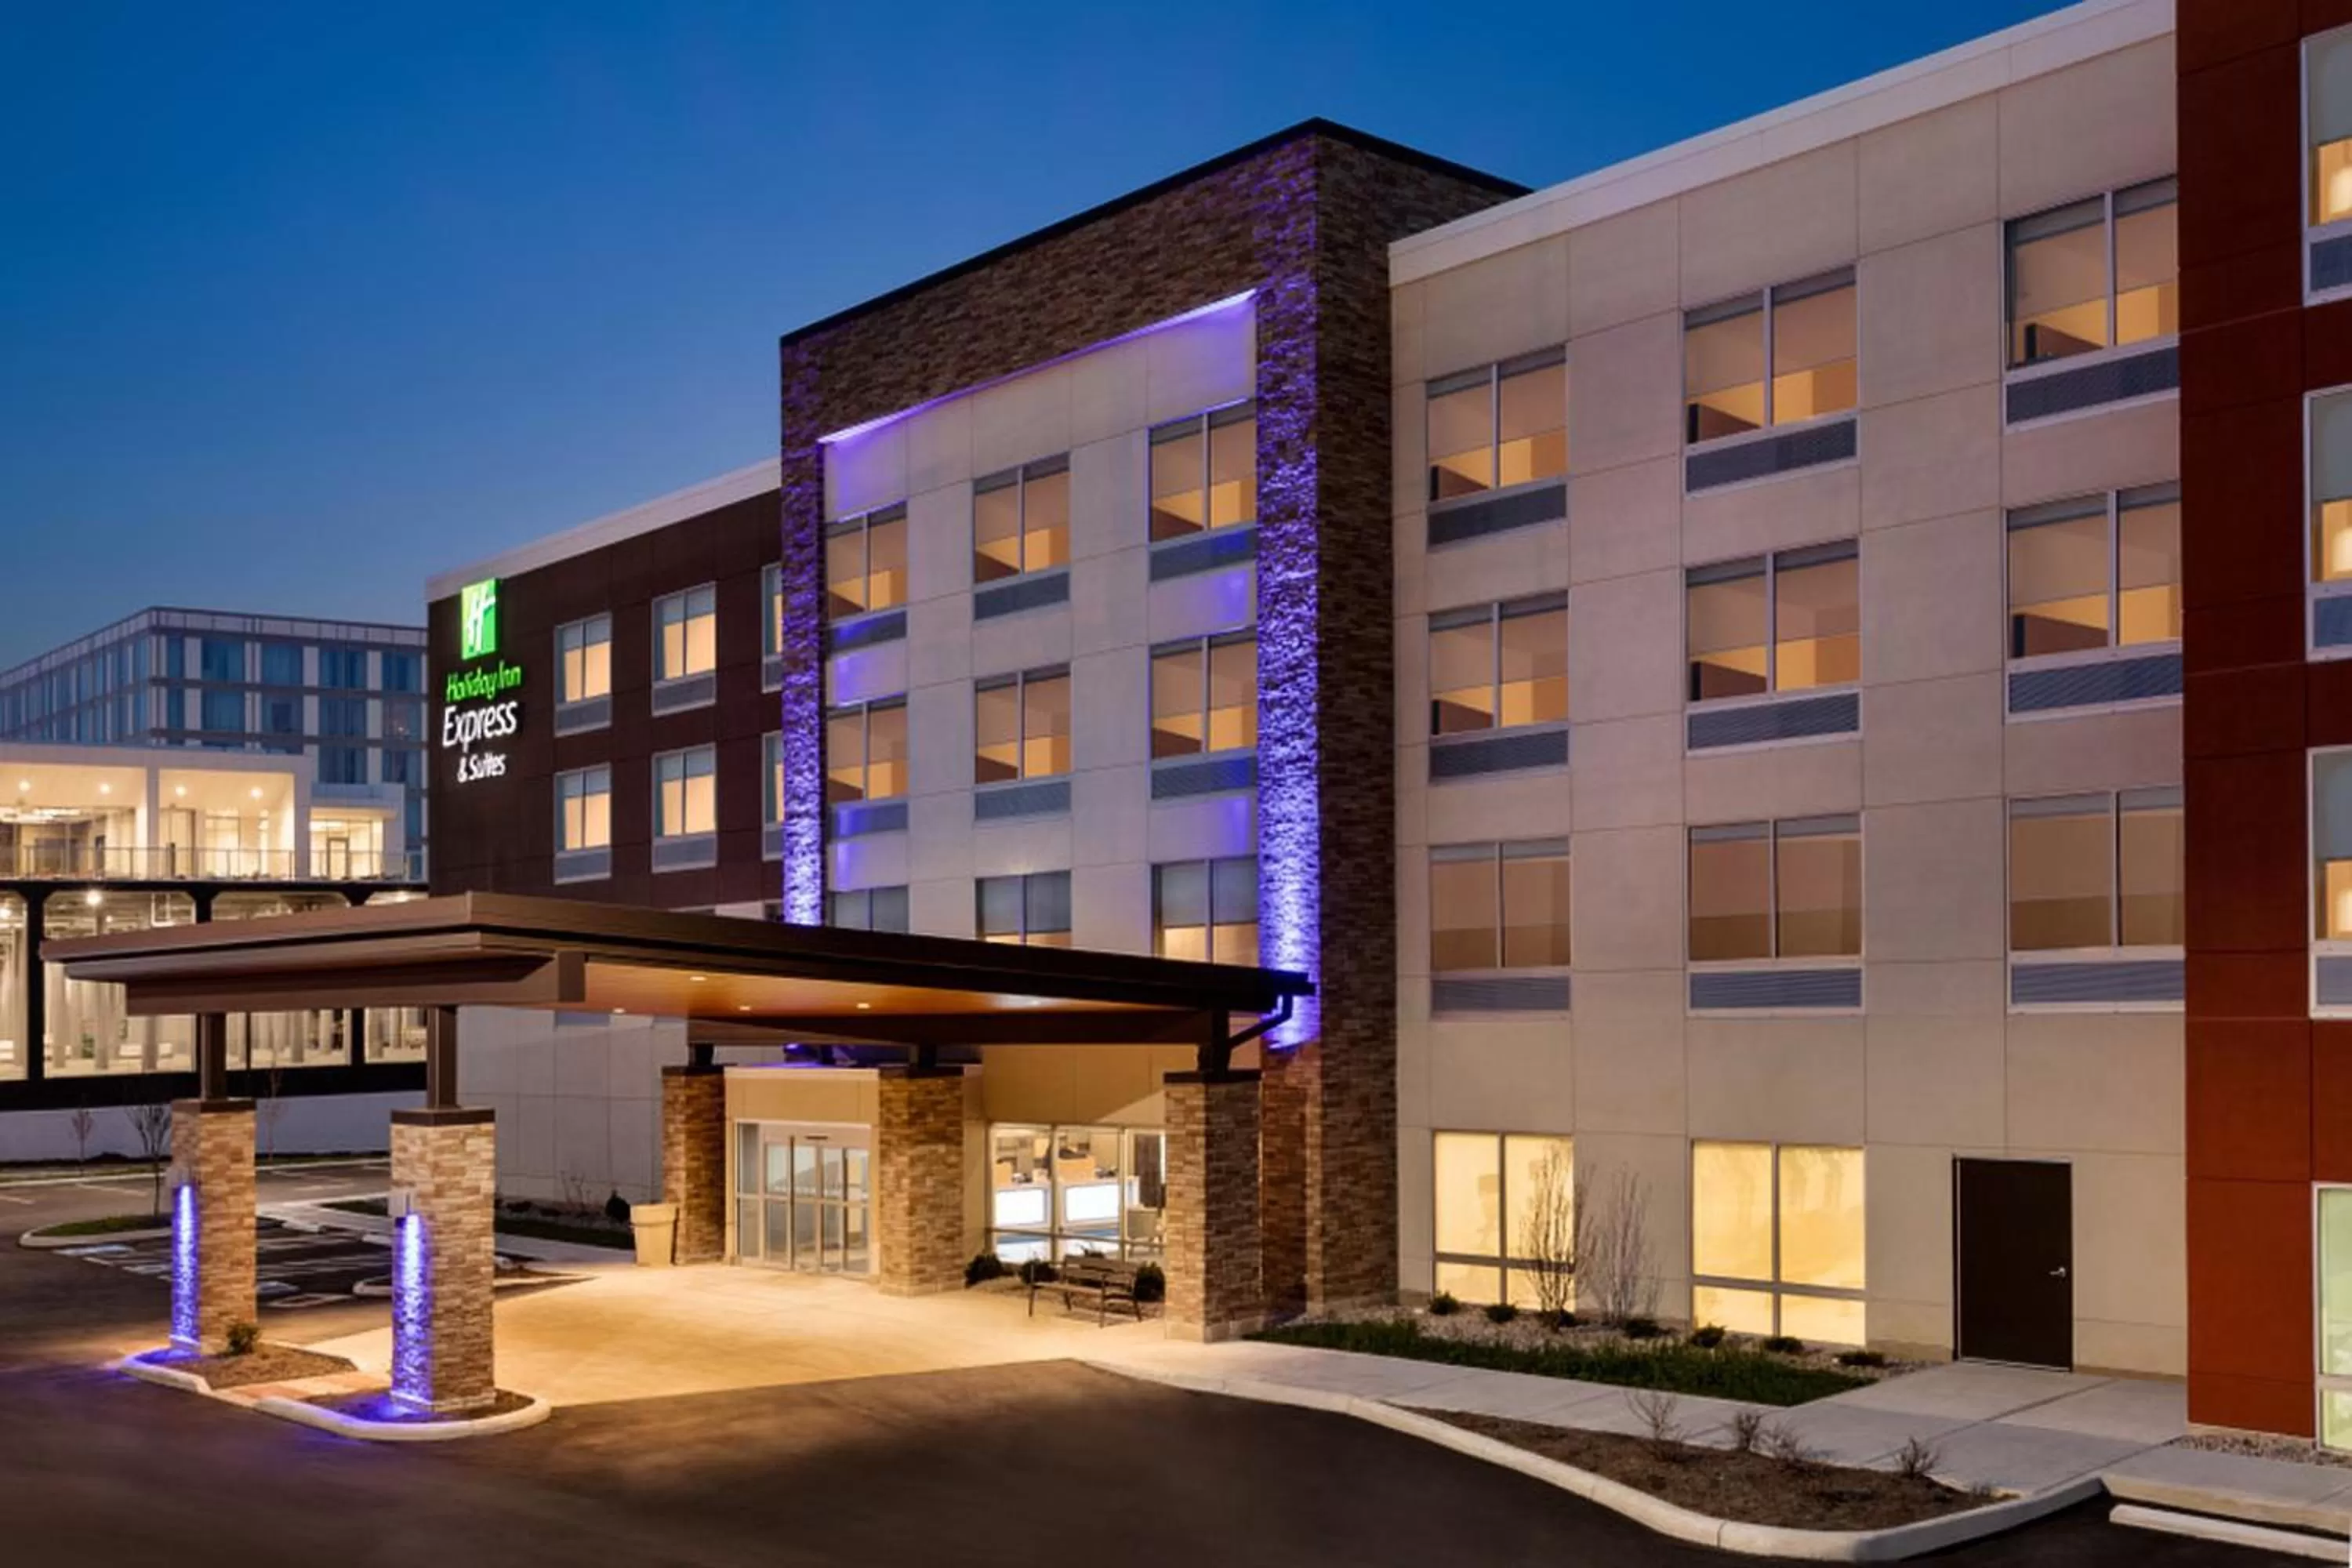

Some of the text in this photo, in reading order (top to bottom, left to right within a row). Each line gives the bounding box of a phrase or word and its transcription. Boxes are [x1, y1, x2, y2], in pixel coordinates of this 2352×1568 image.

[446, 659, 521, 702] Holiday Inn
[442, 701, 517, 753] Express
[457, 752, 506, 782] & Suites
